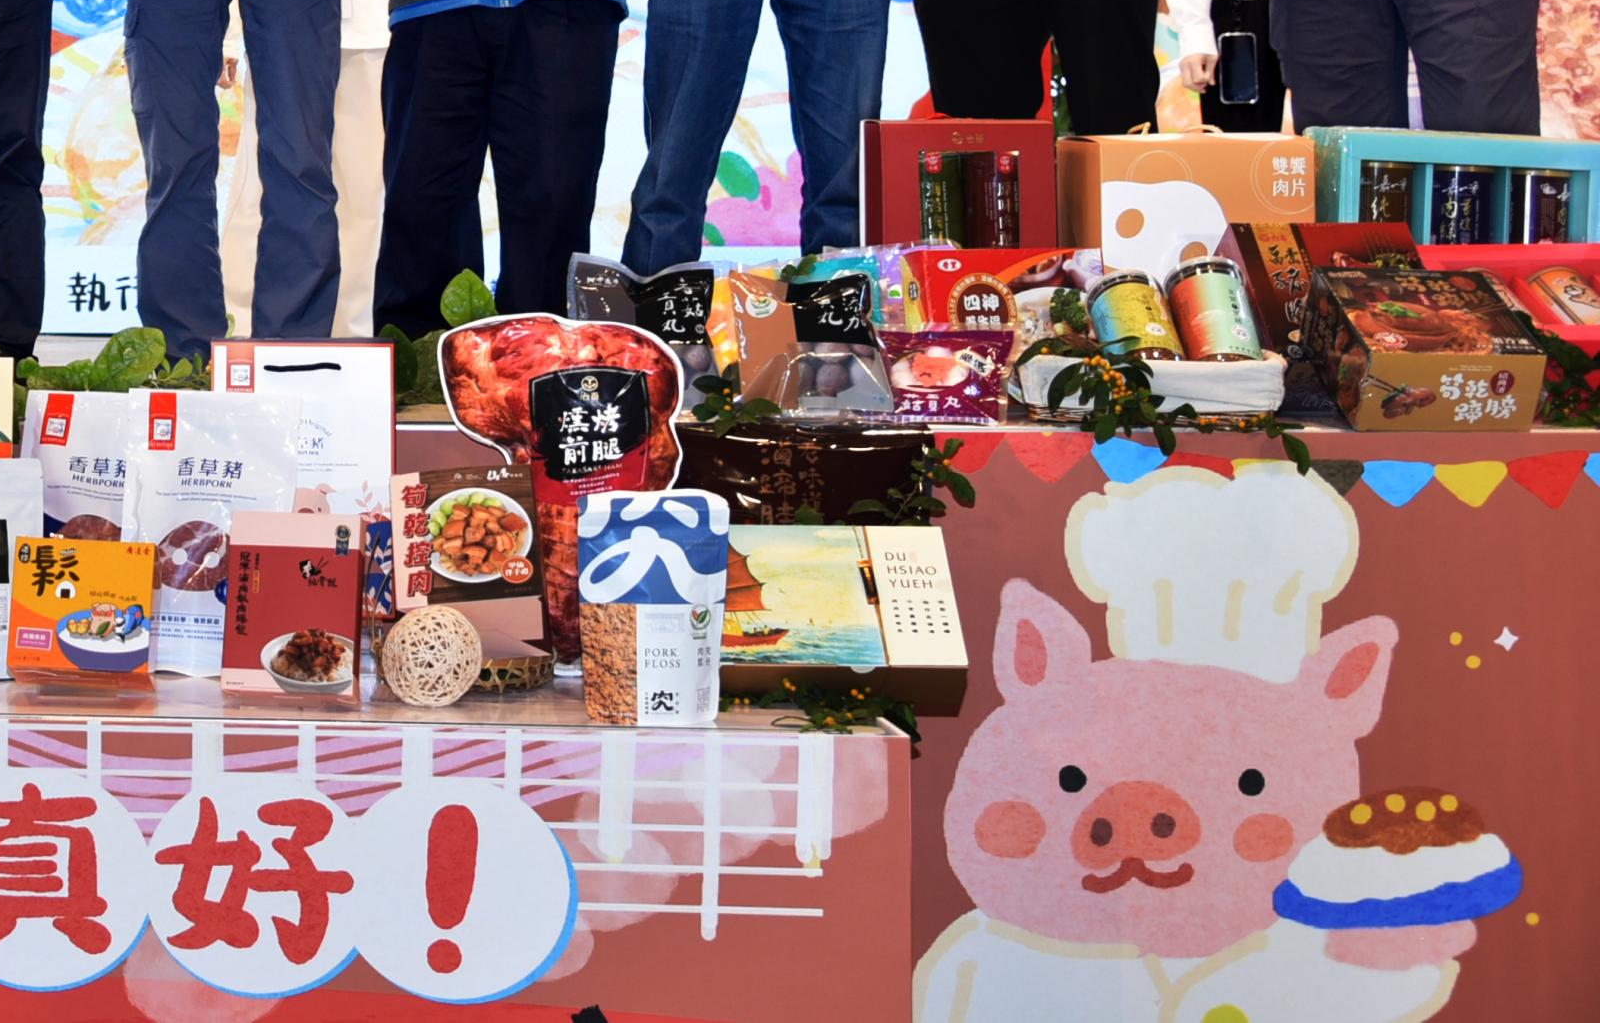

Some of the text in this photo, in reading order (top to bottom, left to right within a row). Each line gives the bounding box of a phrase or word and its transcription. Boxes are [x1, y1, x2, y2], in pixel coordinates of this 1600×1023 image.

[1272, 179, 1306, 197] 肉片
[963, 293, 1000, 311] 四神
[657, 291, 686, 333] 貢丸
[1440, 372, 1489, 400] 筍乾
[558, 436, 624, 466] 前腿
[177, 457, 244, 479] 香草豬
[180, 477, 233, 489] HERBPORK
[884, 552, 907, 562] DU
[886, 565, 937, 575] HSIAO
[888, 579, 934, 589] YUEH
[644, 648, 678, 658] PORK
[644, 659, 682, 669] FLOSS
